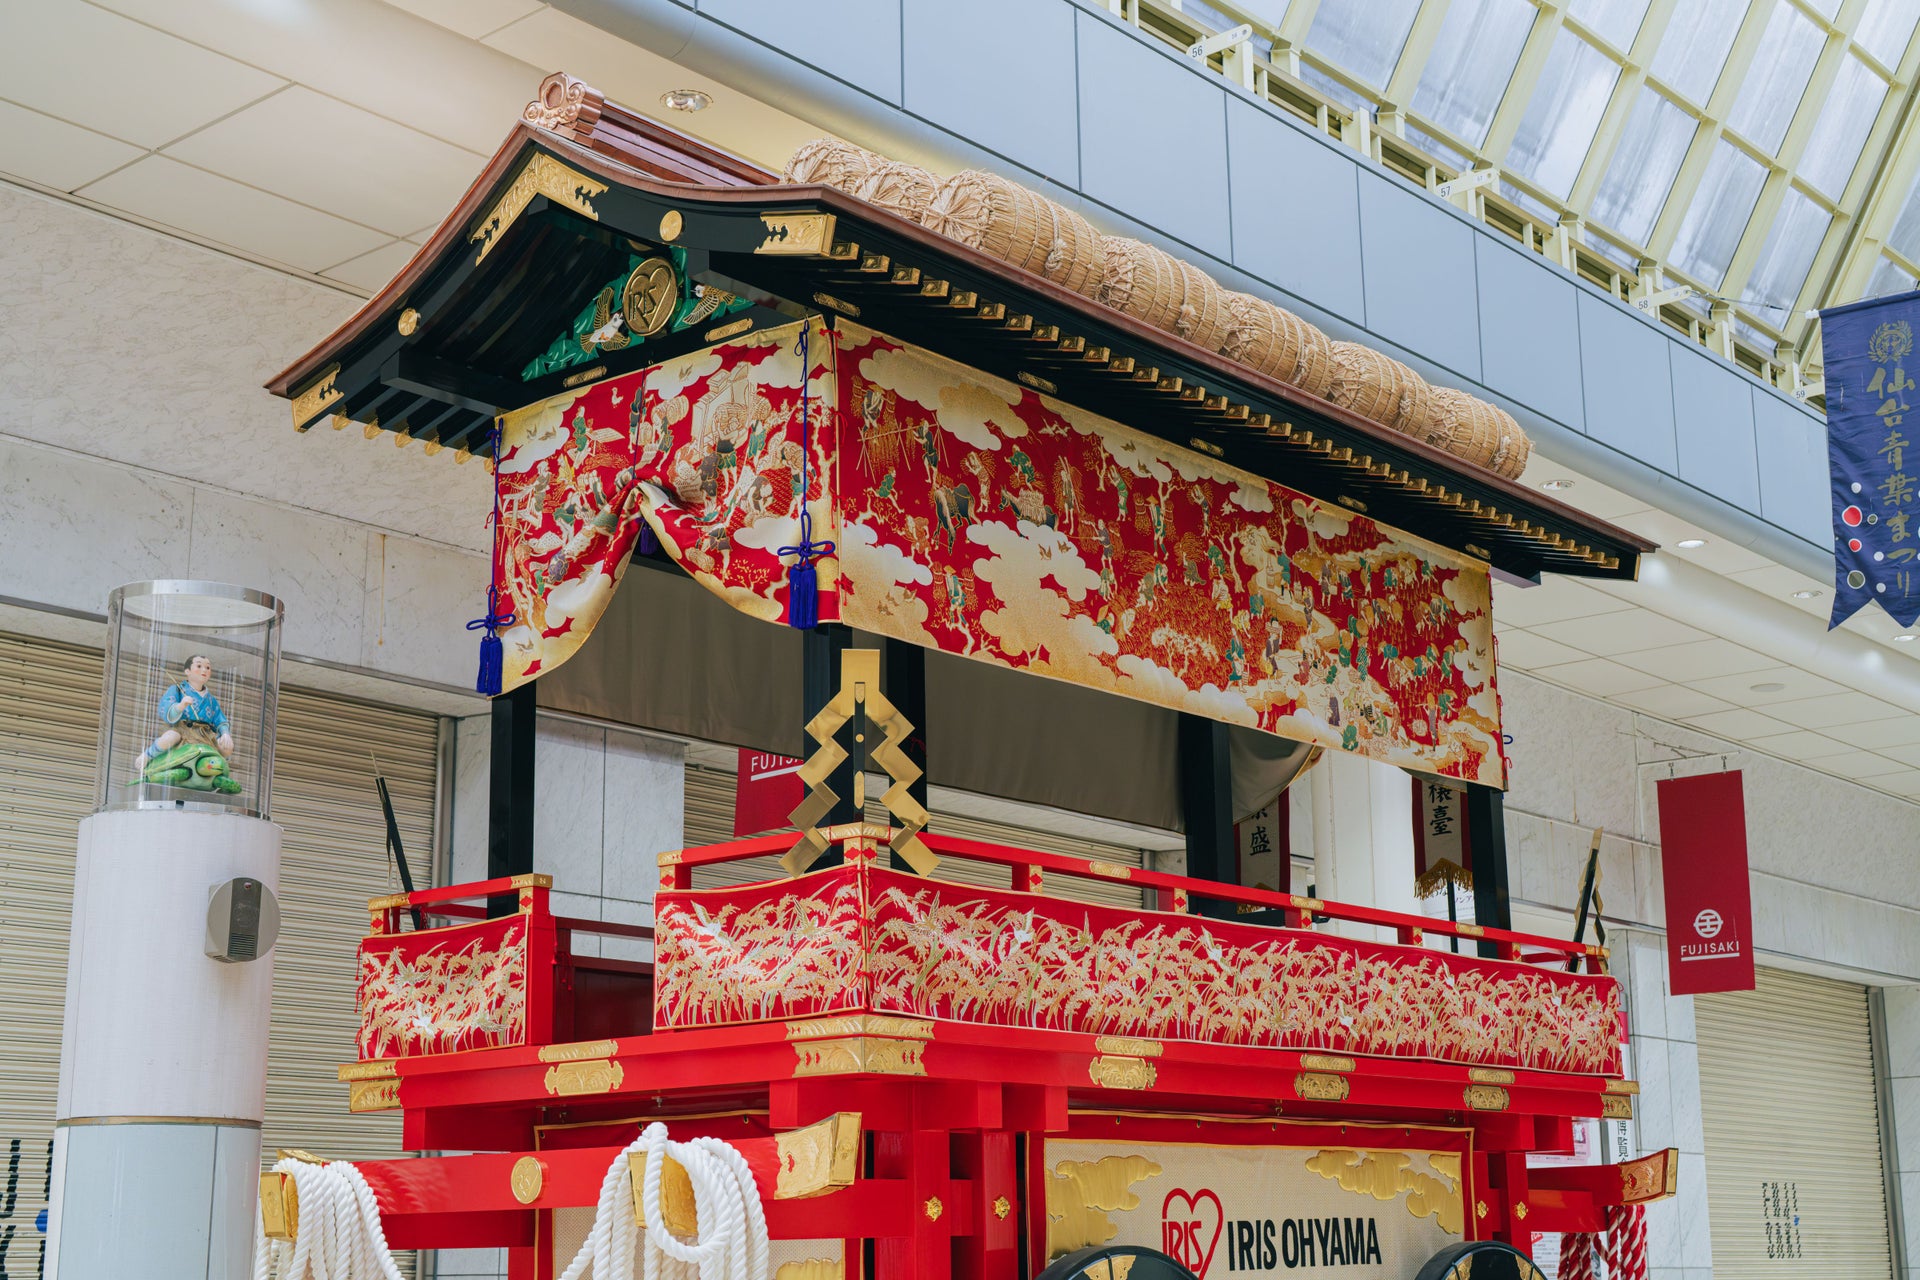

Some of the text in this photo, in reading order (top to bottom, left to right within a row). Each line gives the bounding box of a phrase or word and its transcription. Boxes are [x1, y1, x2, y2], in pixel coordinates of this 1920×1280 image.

[1192, 45, 1203, 58] 56
[1440, 185, 1451, 198] 57
[629, 285, 657, 326] IRIS
[1638, 299, 1649, 310] 58
[1795, 390, 1806, 399] 59
[1866, 367, 1917, 598] 仙台青葉まつり
[1680, 940, 1740, 956] FUJISAKI
[1616, 1120, 1629, 1162] 博覧
[1162, 1220, 1204, 1273] IRIS
[1227, 1217, 1383, 1272] IRIS OHYAMA
